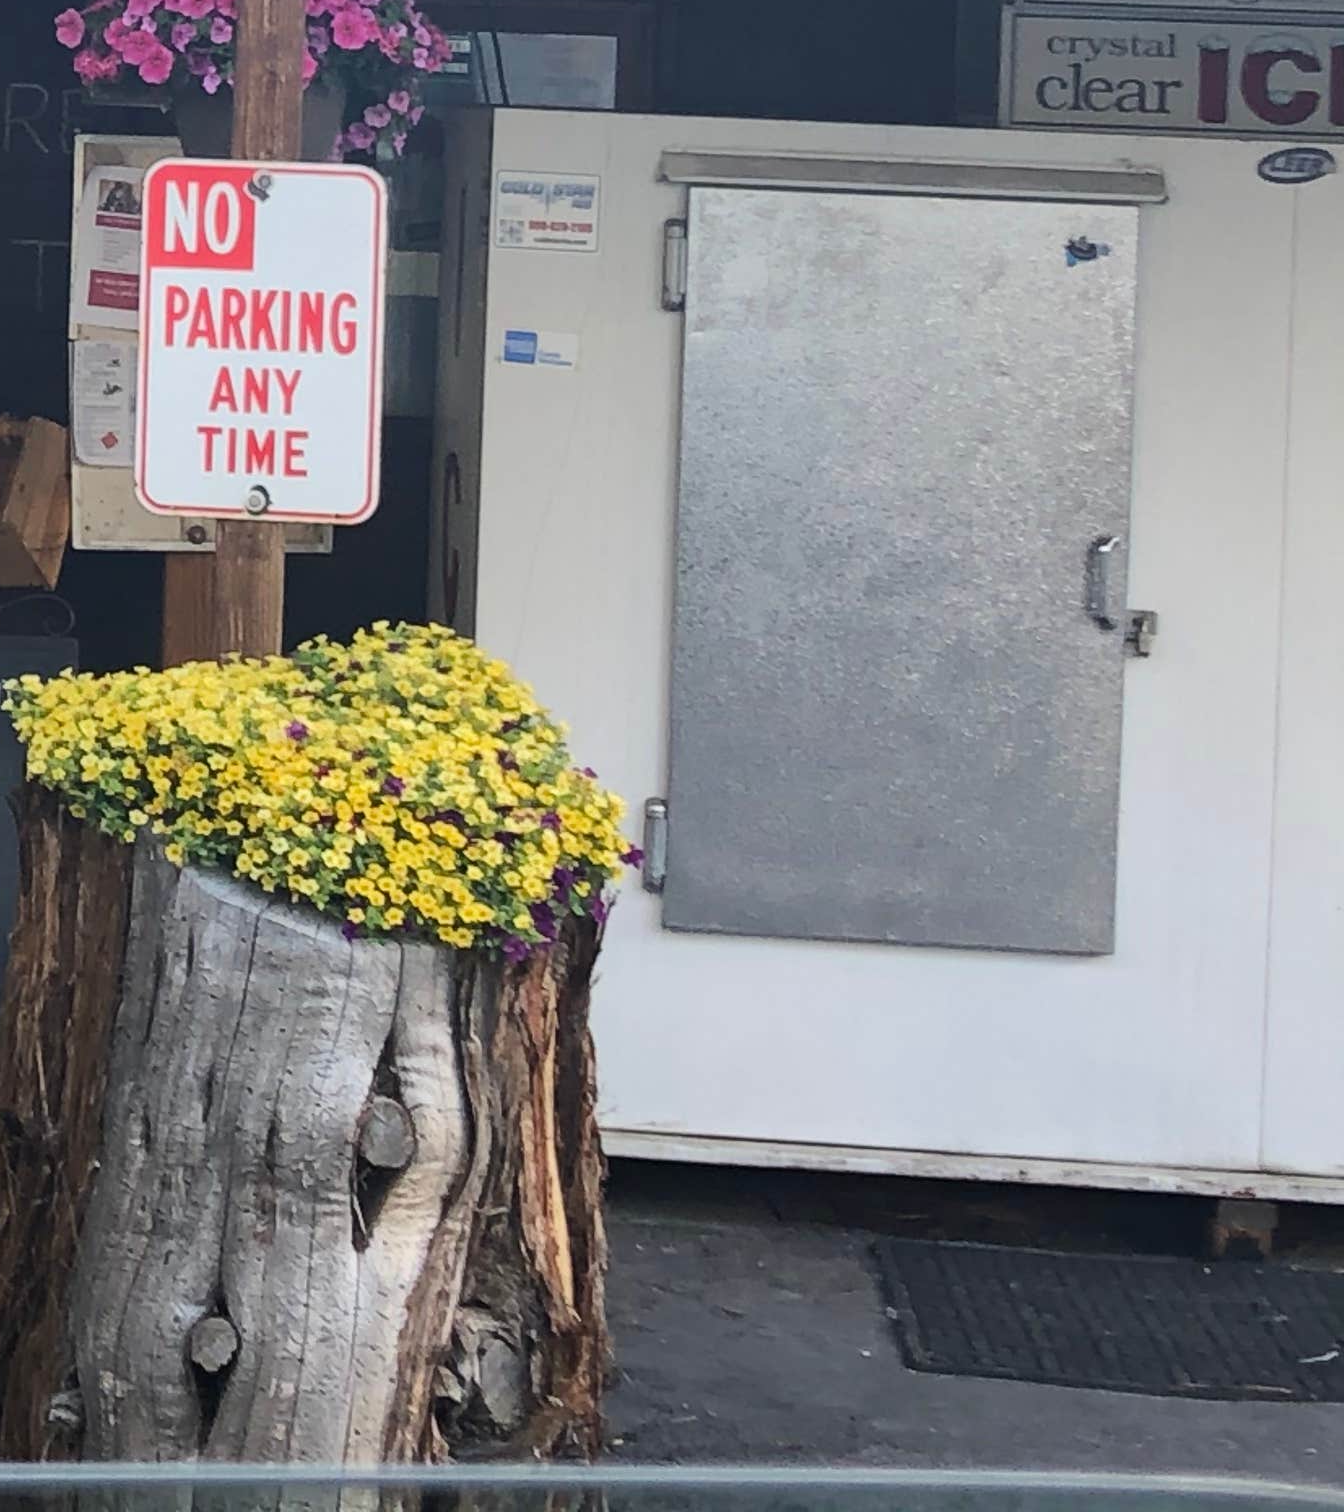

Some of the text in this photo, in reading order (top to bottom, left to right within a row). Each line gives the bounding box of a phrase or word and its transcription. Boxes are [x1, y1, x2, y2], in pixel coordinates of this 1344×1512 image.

[1046, 33, 1178, 62] crystal
[1035, 32, 1344, 127] clear IC
[161, 180, 243, 256] NO
[163, 284, 358, 356] PARKING
[209, 365, 303, 416] ANY
[196, 426, 310, 478] TIME
